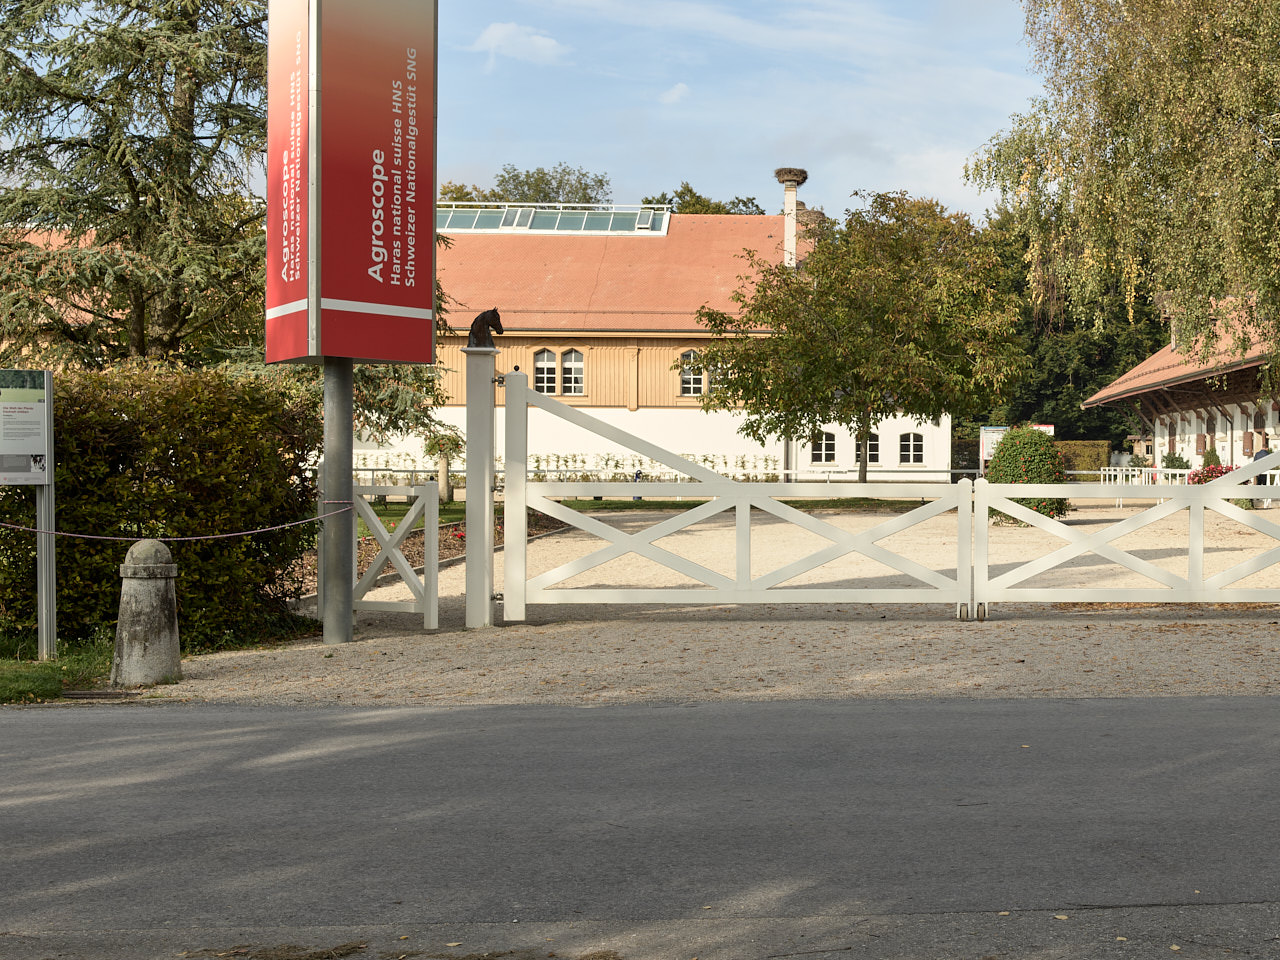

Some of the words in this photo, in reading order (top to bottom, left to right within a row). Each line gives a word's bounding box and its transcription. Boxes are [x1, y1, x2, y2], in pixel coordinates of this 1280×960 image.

[406, 47, 416, 80] SNG
[392, 80, 402, 114] HNS
[392, 119, 402, 165] suisse
[405, 85, 418, 202] Nationalgestüt
[282, 150, 290, 282] Agroscope
[368, 149, 388, 283] Agroscope
[391, 170, 402, 235] national
[391, 241, 401, 285] Haras
[405, 207, 415, 287] Schweizer
